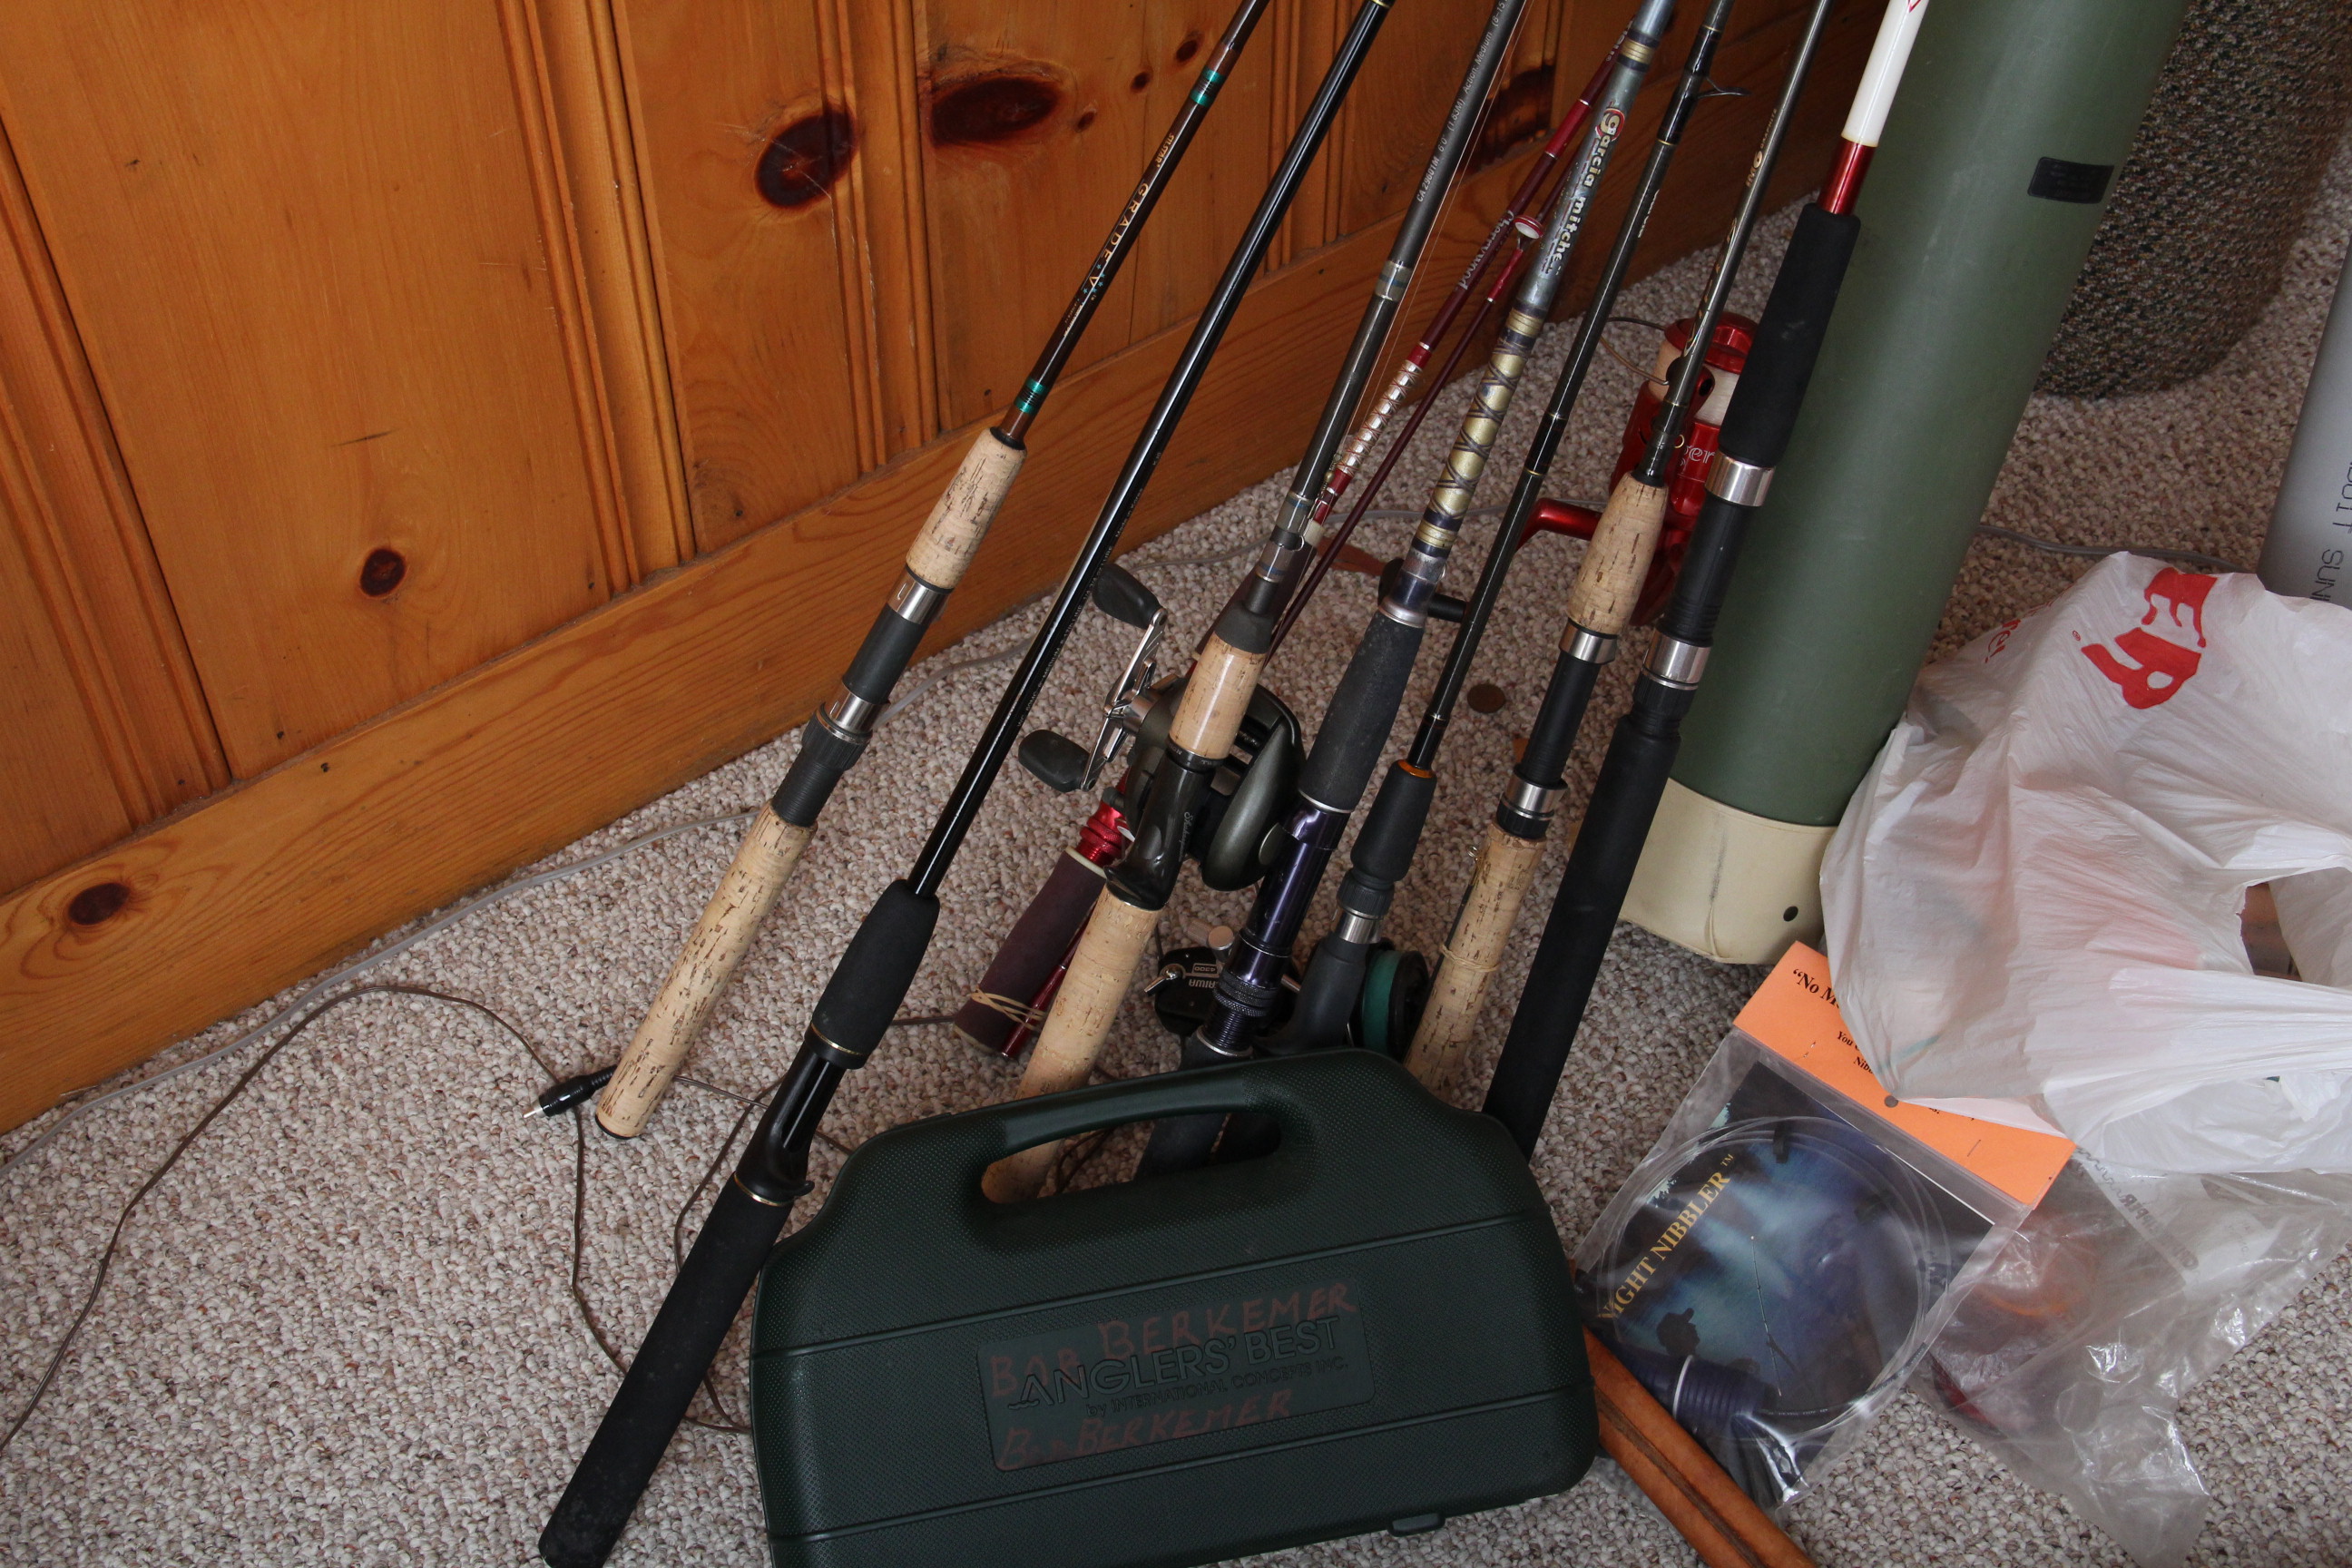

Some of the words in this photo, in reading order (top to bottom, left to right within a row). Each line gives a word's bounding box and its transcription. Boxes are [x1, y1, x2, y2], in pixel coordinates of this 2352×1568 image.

[1475, 32, 1494, 64] Medium
[1583, 109, 1622, 190] garcia
[1101, 181, 1150, 262] GRADE
[1188, 977, 1218, 989] AIWA
[1837, 1030, 1854, 1046] You
[1597, 1257, 1658, 1324] NIGHT
[1650, 1169, 1731, 1261] NIBBLER
[1099, 1282, 1357, 1361] BERKEMER
[1245, 1316, 1341, 1361] BEST
[1086, 1402, 1107, 1418] by
[1110, 1377, 1228, 1414] INTERNATIONAL
[1231, 1362, 1313, 1391] CONCEPTS
[1075, 1389, 1293, 1457] BERKEMER
